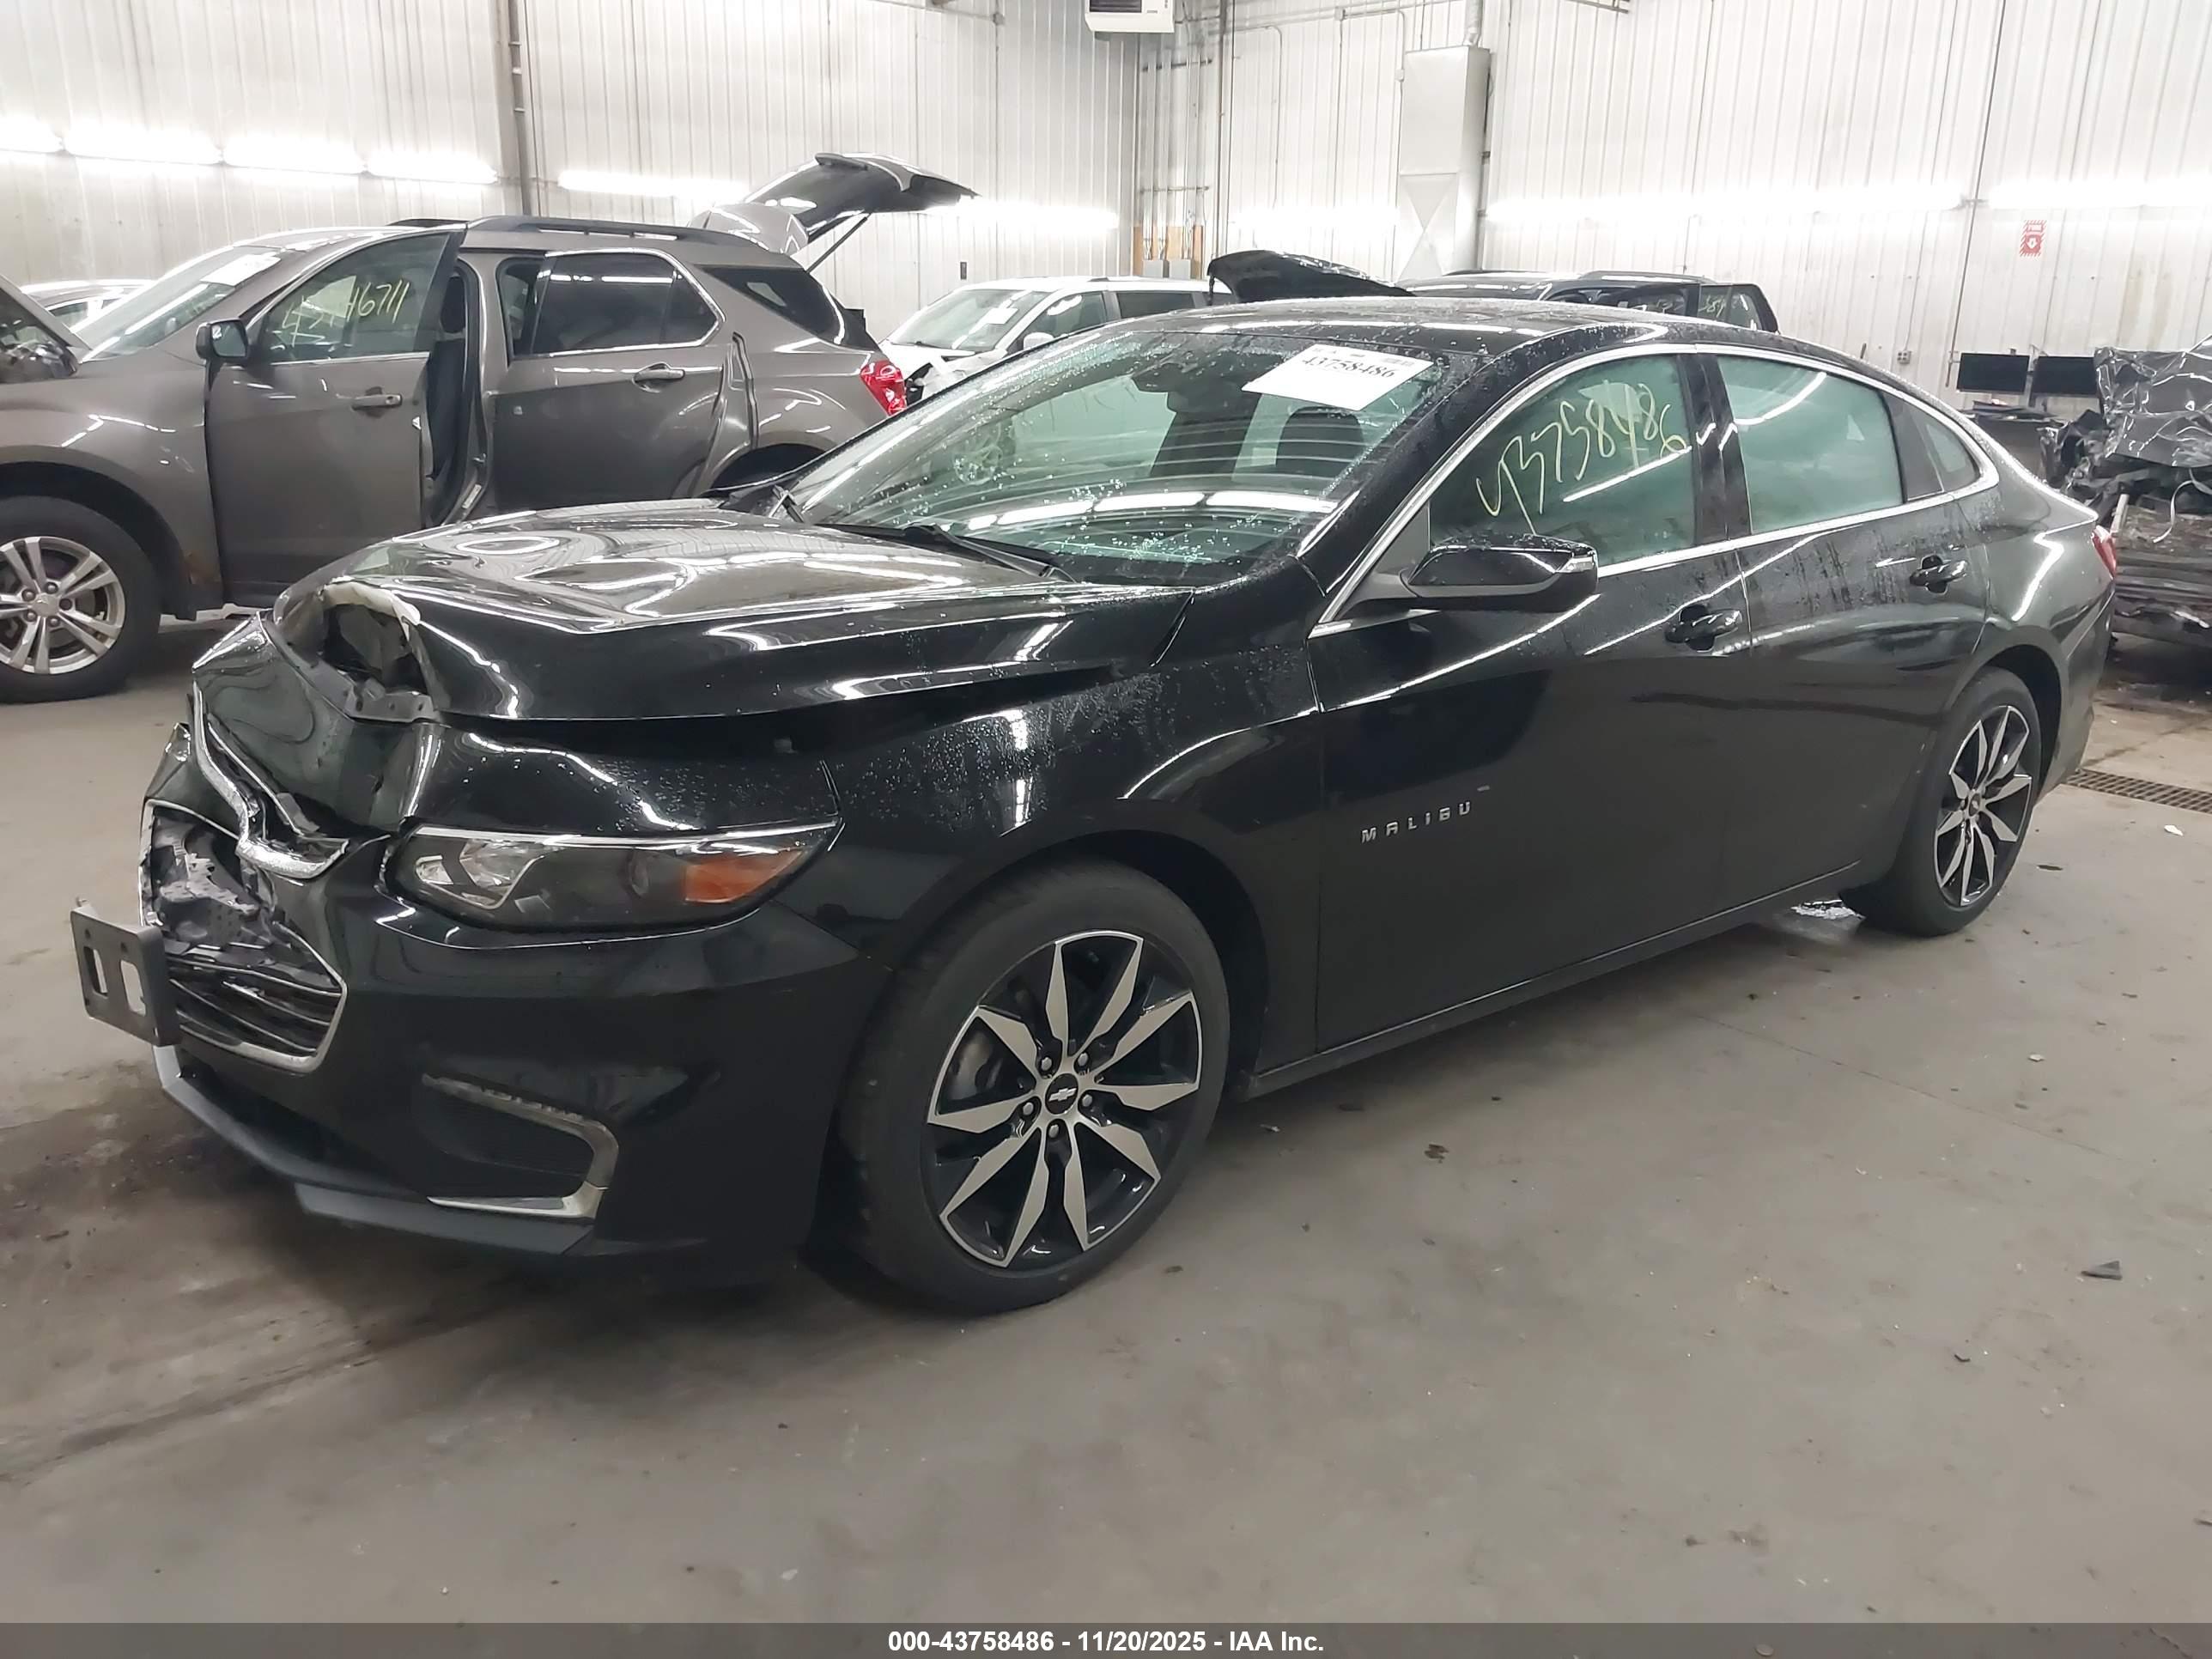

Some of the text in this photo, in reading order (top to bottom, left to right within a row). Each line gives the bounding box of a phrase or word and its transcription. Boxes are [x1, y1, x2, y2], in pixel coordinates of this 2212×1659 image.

[1302, 356, 1395, 378] 43758486
[1475, 379, 1687, 535] 43758486
[1361, 801, 1471, 843] MALIBU
